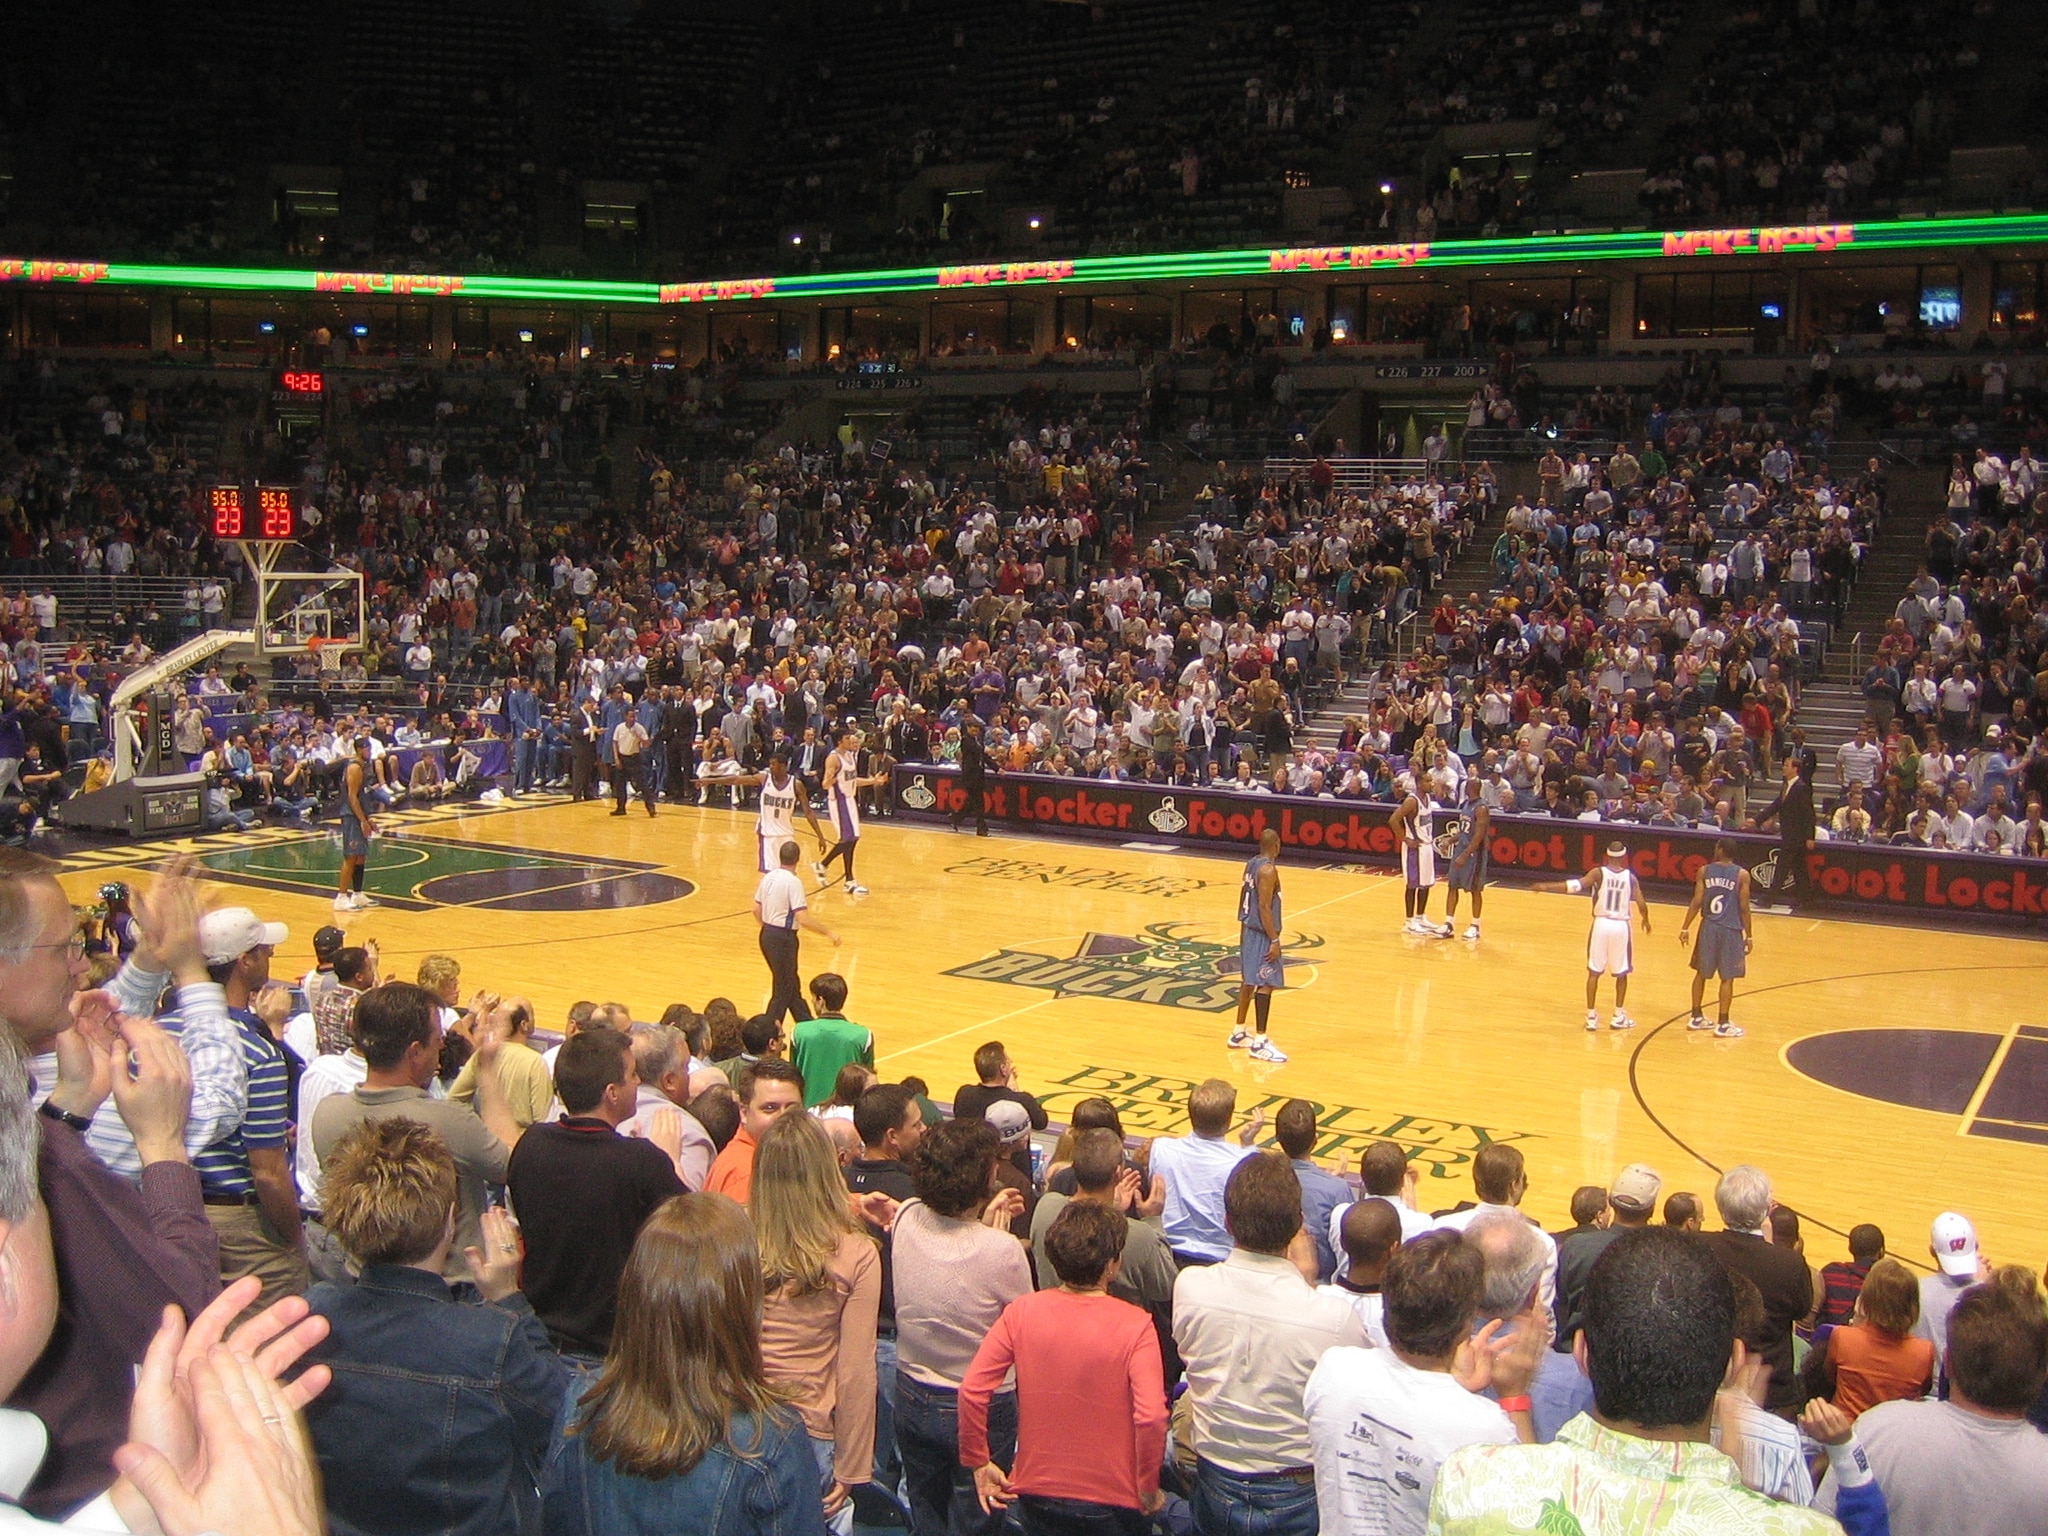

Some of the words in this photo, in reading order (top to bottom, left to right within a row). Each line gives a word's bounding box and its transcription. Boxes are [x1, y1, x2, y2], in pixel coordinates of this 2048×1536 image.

[1663, 228, 1751, 256] MAKE
[1758, 224, 1854, 253] NOISE
[1270, 247, 1345, 272] MAKE
[1350, 243, 1431, 267] NOISE
[30, 261, 110, 283] NOISE
[316, 272, 387, 293] MAKE
[392, 274, 465, 296] NOISE
[938, 264, 1002, 287] MAKE
[1006, 260, 1075, 284] NOISE
[660, 281, 713, 304] MAKE
[717, 278, 775, 299] NOISE
[284, 373, 321, 391] 9:26
[1421, 366, 1441, 377] 227
[1454, 366, 1474, 377] 200
[212, 491, 238, 507] 35.0
[261, 491, 288, 508] 35.0
[216, 507, 241, 535] 23
[265, 508, 291, 535] 23
[1018, 785, 1134, 829] Locker
[1187, 800, 1268, 839] Foot
[1488, 827, 1567, 869] oot
[1582, 834, 1715, 881] Lcke
[943, 864, 1189, 898] CENTER
[962, 856, 1238, 890] BRADLEY
[1705, 877, 1736, 891] DANIELS
[1806, 854, 1907, 901] Foot
[1925, 863, 2048, 913] Lock
[1605, 889, 1621, 912] 11
[1709, 894, 1725, 915] 6
[961, 953, 1241, 1011] BUCKS
[1045, 1064, 1550, 1151] BRDLEY
[1949, 1237, 1967, 1252] W
